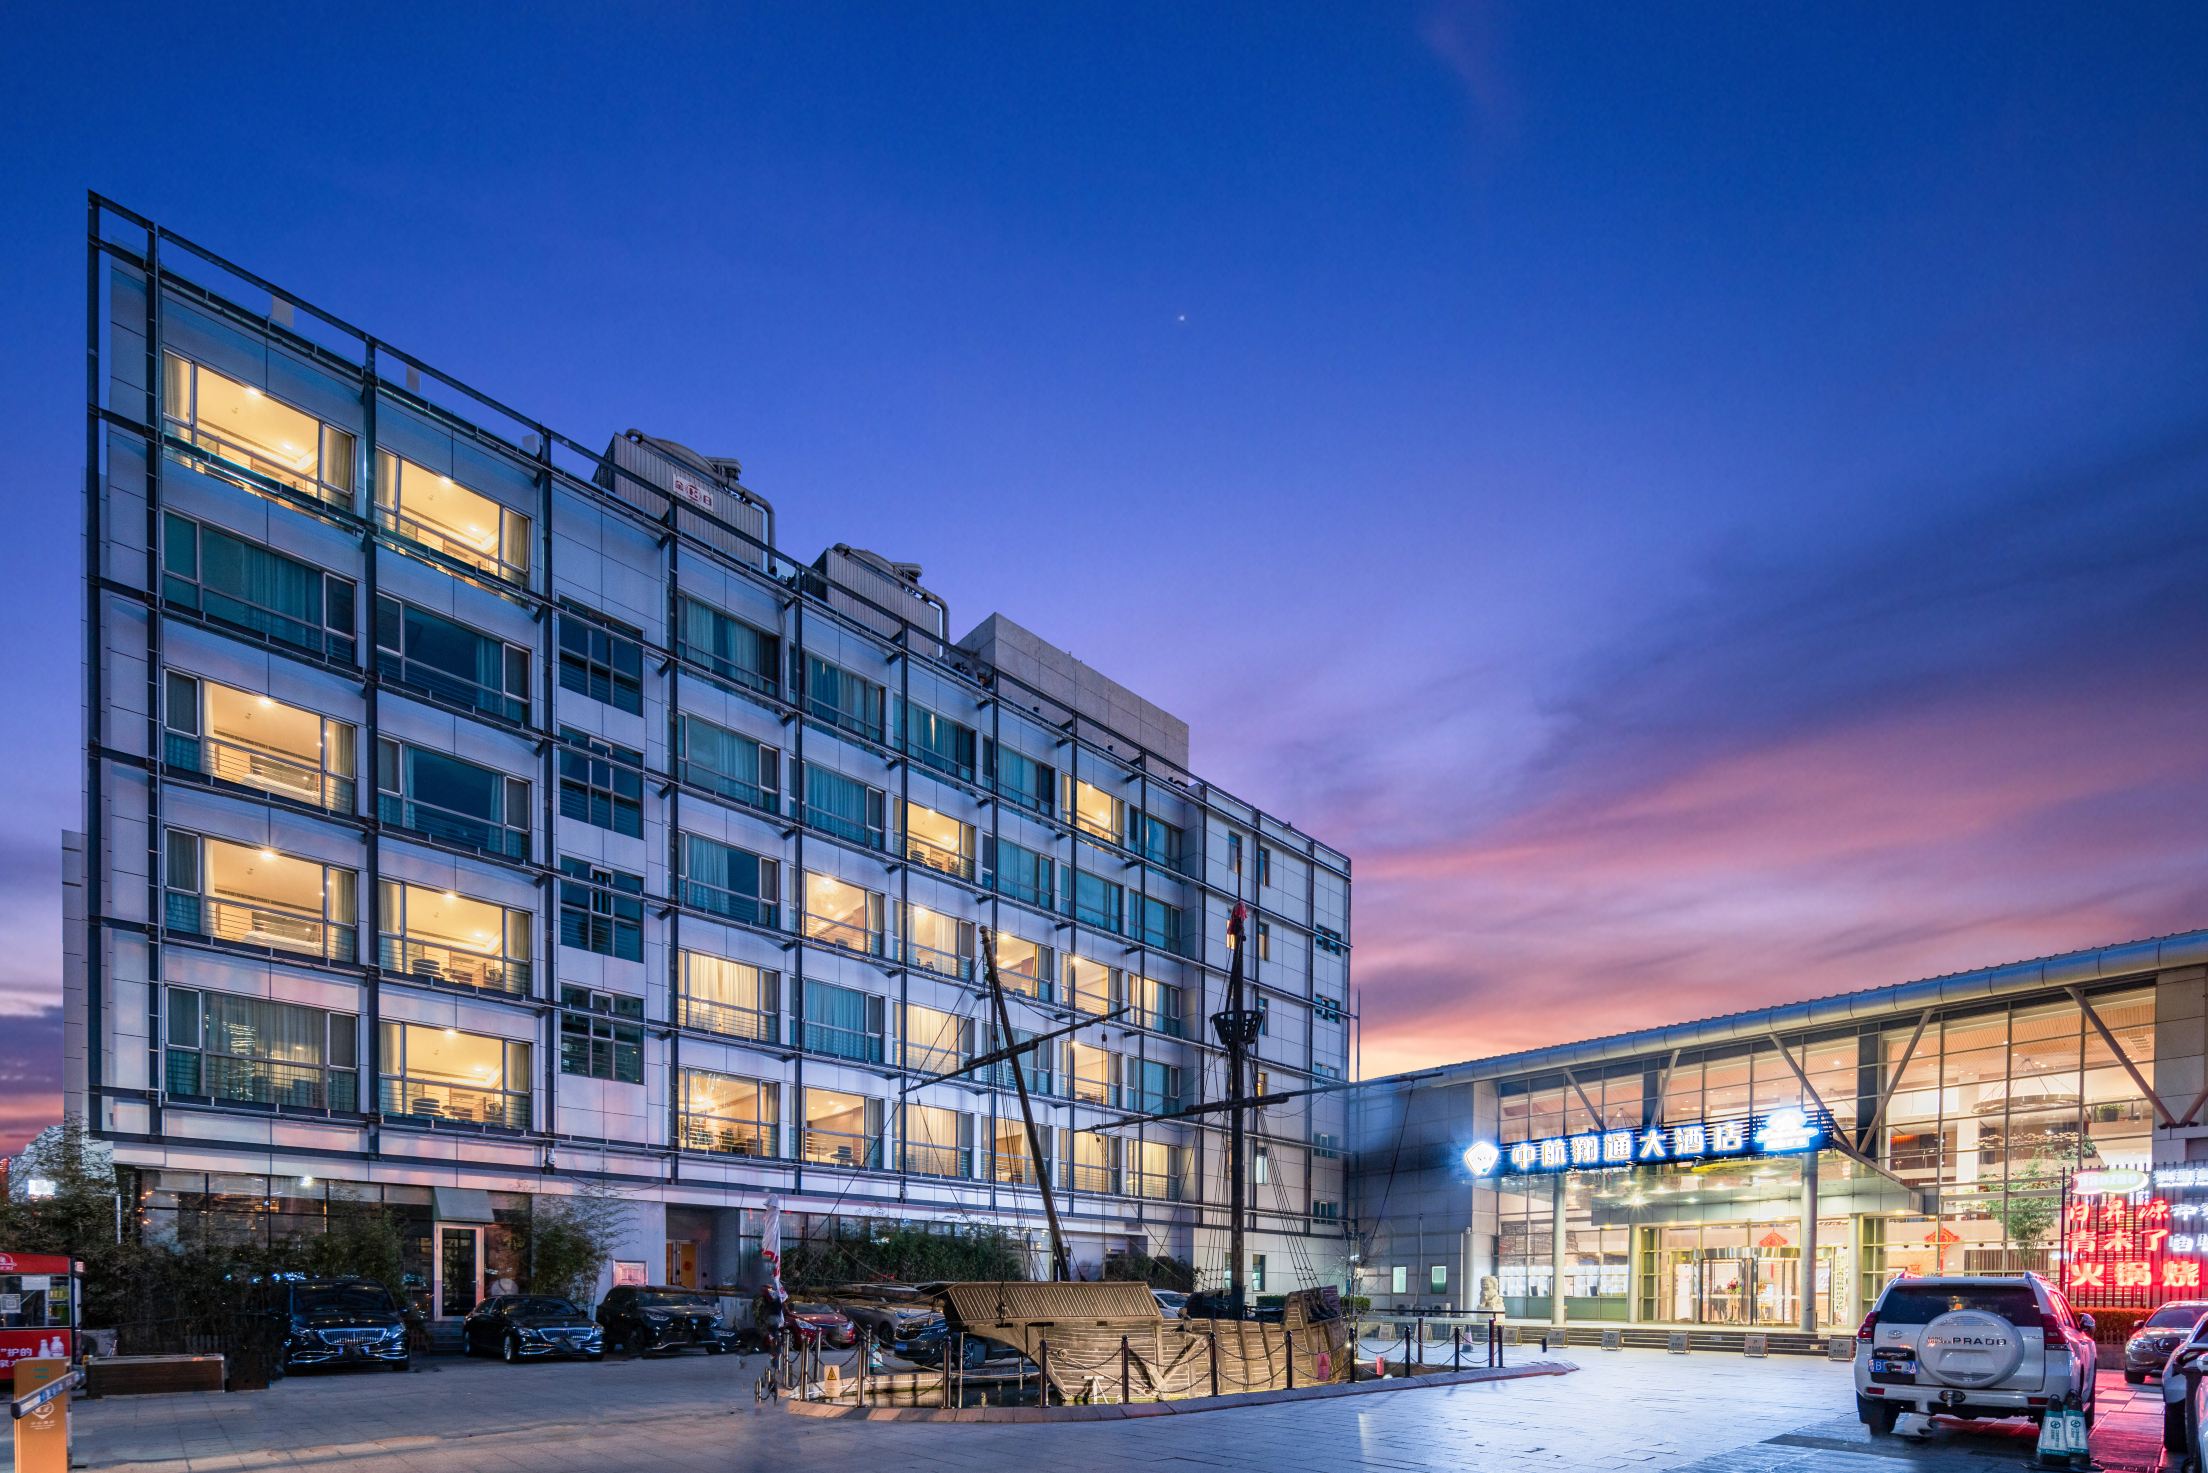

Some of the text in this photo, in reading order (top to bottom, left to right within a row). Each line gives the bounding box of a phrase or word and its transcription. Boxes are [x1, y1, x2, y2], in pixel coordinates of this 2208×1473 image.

[1512, 1121, 1743, 1168] 中航翔通大酒店
[2069, 1229, 2169, 1253] 青未了
[2069, 1261, 2201, 1288] 火锅烧
[1952, 1337, 2007, 1346] PRADO
